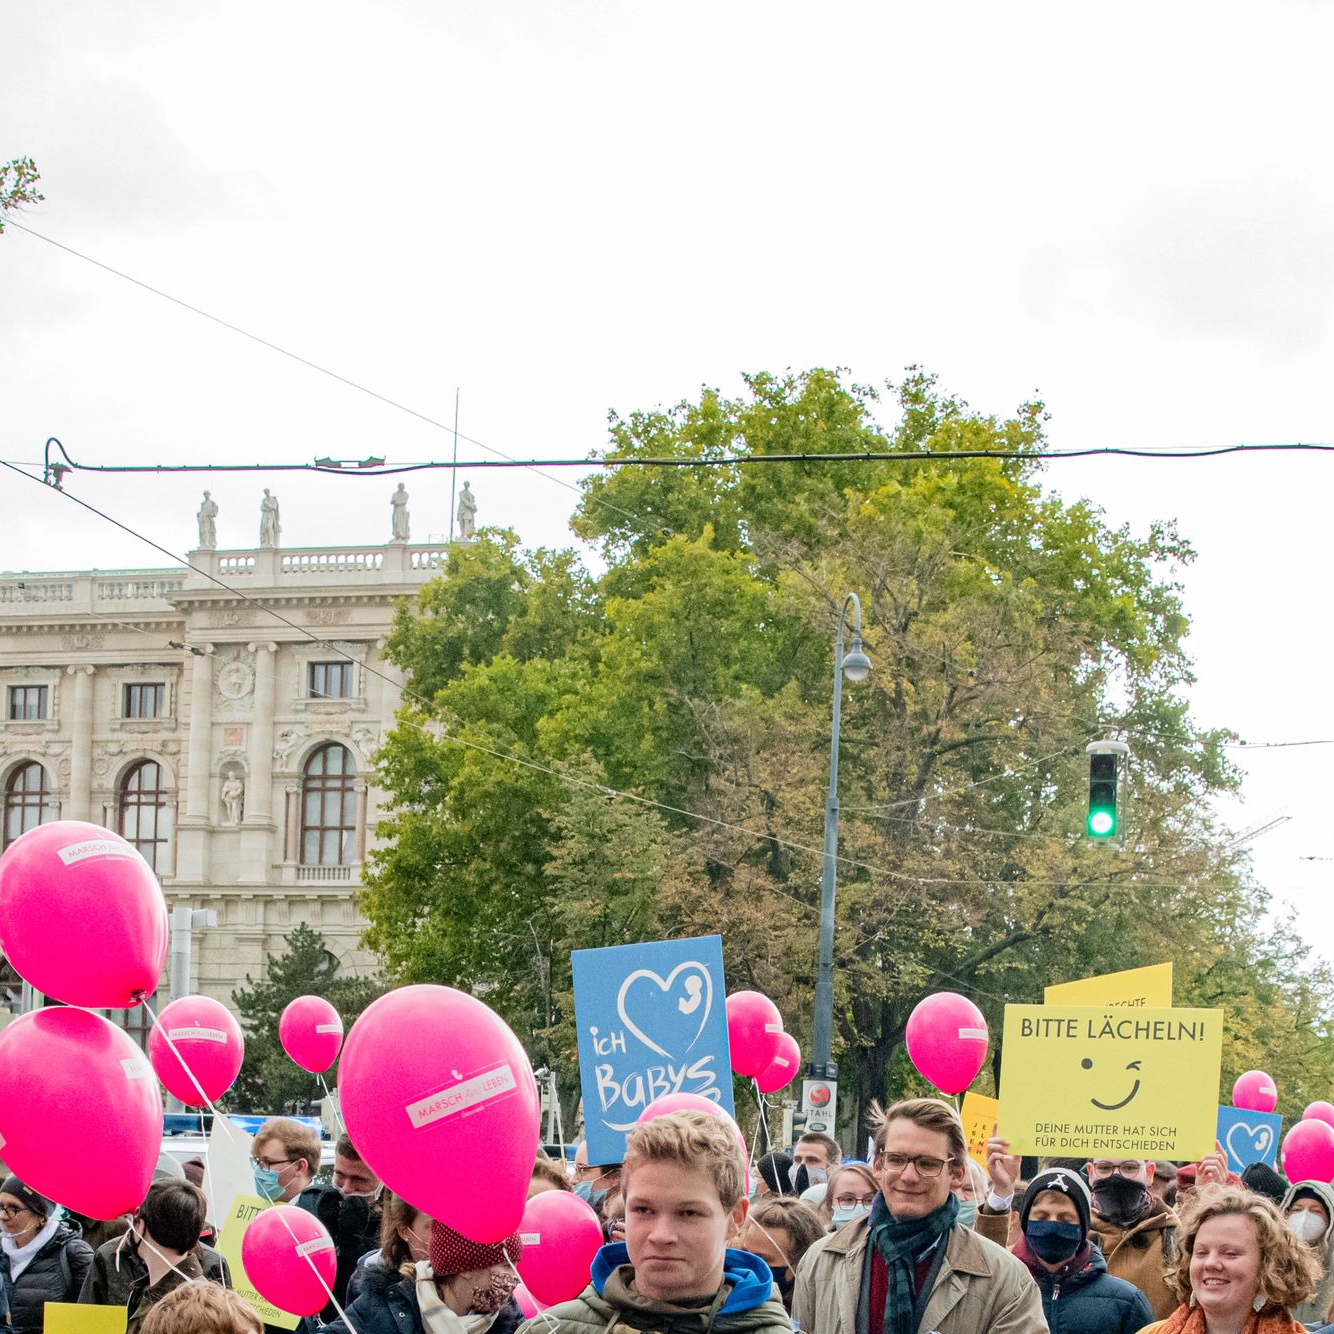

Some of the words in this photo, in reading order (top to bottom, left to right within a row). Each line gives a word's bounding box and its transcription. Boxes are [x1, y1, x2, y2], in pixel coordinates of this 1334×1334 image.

[68, 843, 107, 859] MARSCH
[1020, 1018, 1079, 1039] BITTE
[1087, 1015, 1205, 1042] LÄCHELN!
[418, 1093, 464, 1119] MARSCH
[482, 1075, 508, 1092] LEBEN
[1034, 1123, 1072, 1134] DEINE
[1075, 1124, 1119, 1136] MUTTER
[1122, 1126, 1147, 1137] HAT
[1150, 1126, 1177, 1138] SICH
[1034, 1135, 1056, 1147] FÜR
[1060, 1137, 1089, 1149] DICH
[1092, 1139, 1176, 1151] ENTSCHIEDEN
[236, 1204, 266, 1220] BITT
